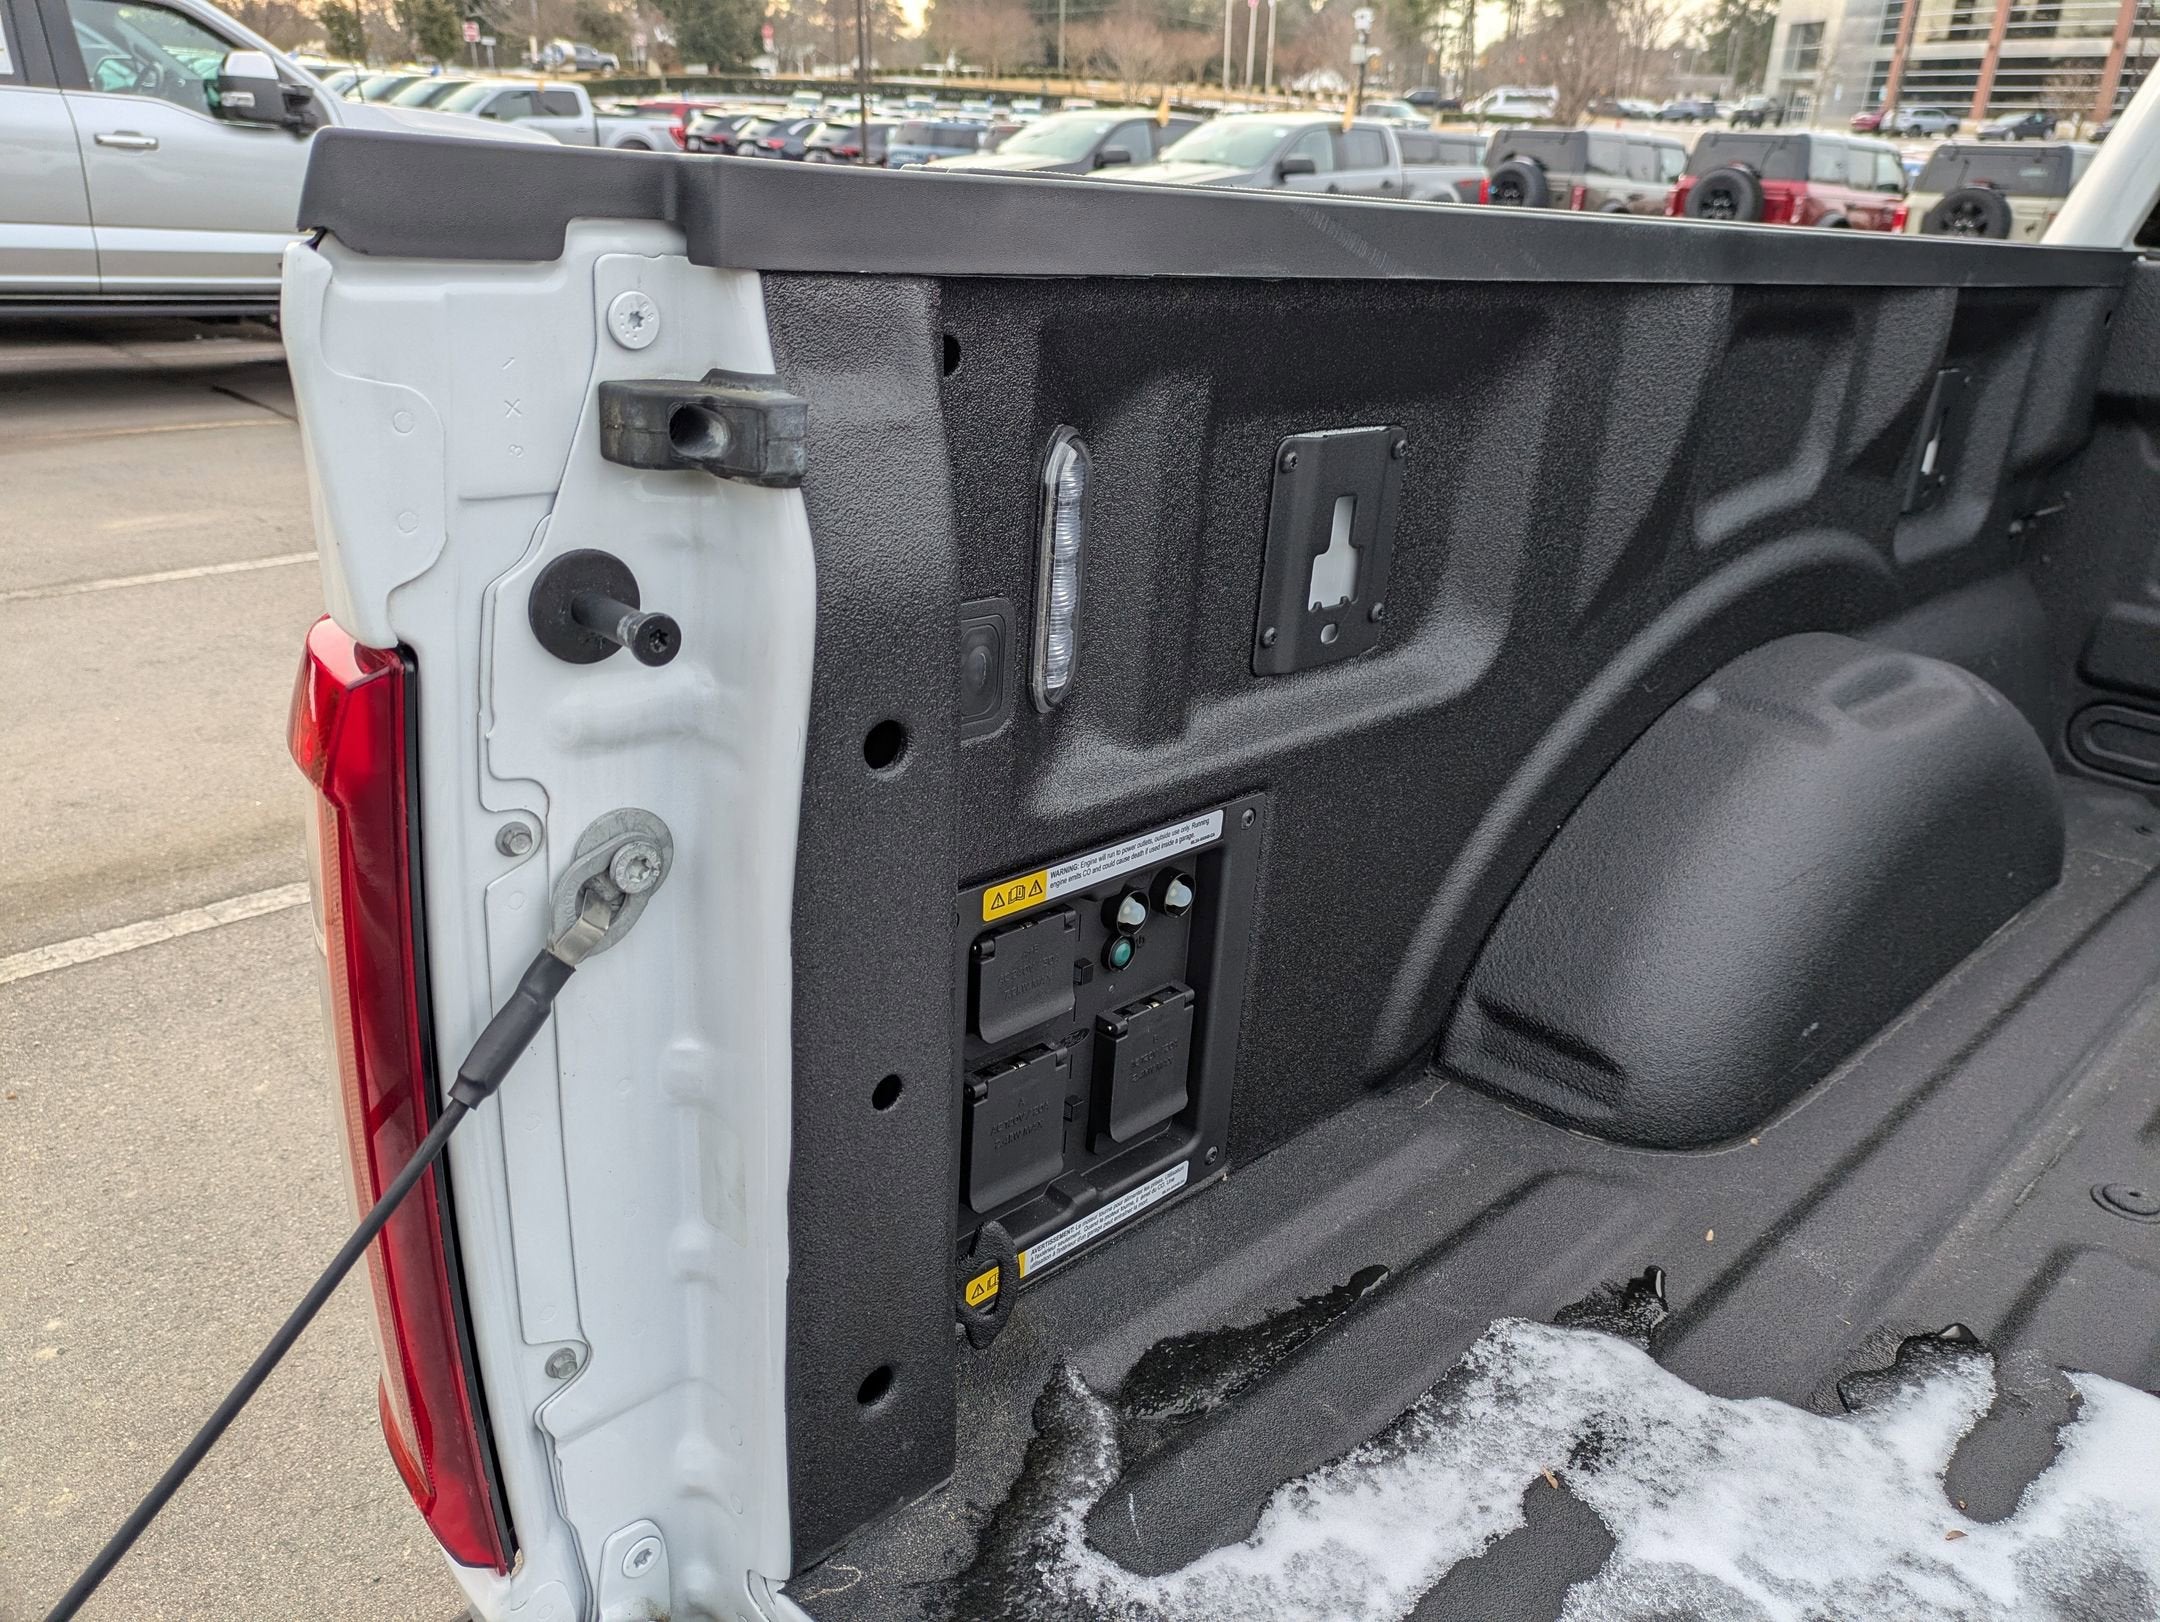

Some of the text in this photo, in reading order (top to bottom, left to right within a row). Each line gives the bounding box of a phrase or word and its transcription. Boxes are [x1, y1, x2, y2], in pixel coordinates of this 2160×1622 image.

[1050, 879, 1067, 889] engine
[1083, 869, 1091, 877] CO
[1102, 860, 1116, 870] could
[1116, 856, 1130, 865] cause
[1131, 850, 1144, 859] death
[1149, 845, 1160, 853] used
[1161, 839, 1174, 848] inside
[1051, 863, 1079, 878] WARNING:
[1081, 857, 1097, 868] Engine
[1122, 844, 1136, 854] power
[1155, 832, 1171, 842] outside
[1192, 818, 1210, 829] Running
